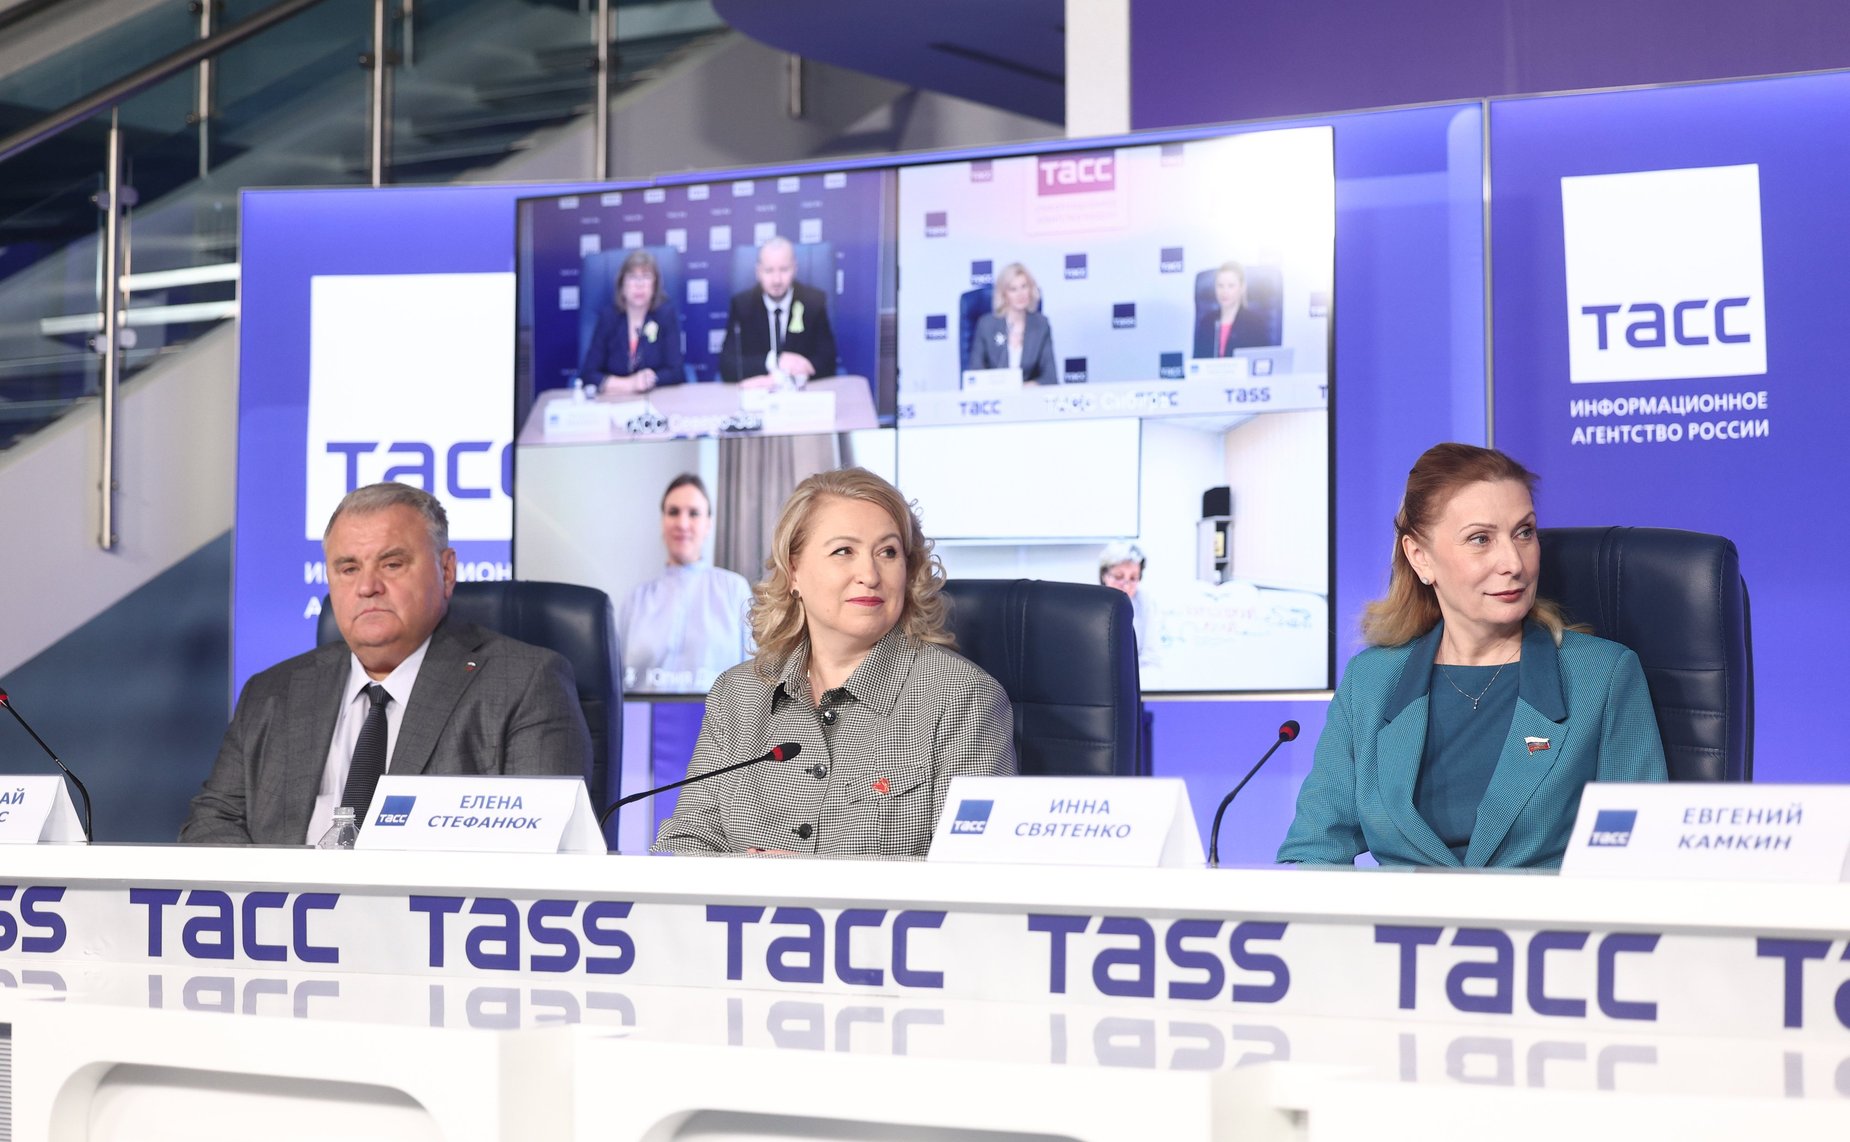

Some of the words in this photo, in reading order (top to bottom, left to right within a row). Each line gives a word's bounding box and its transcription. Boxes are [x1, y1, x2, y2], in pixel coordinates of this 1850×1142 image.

[1570, 391, 1769, 418] ИНФОРМАЦИОННОЕ
[1570, 423, 1683, 445] АГЕНТСТВО
[1688, 419, 1770, 440] РОССИИ
[459, 795, 524, 810] ЕЛЕНА
[1049, 799, 1111, 815] ИННА
[1682, 802, 1803, 825] ЕВГЕНИЙ
[427, 815, 542, 829] СТЕФАНЮК
[1014, 822, 1132, 838] СВЯТЕНКО
[1678, 834, 1793, 850] КАМКИН
